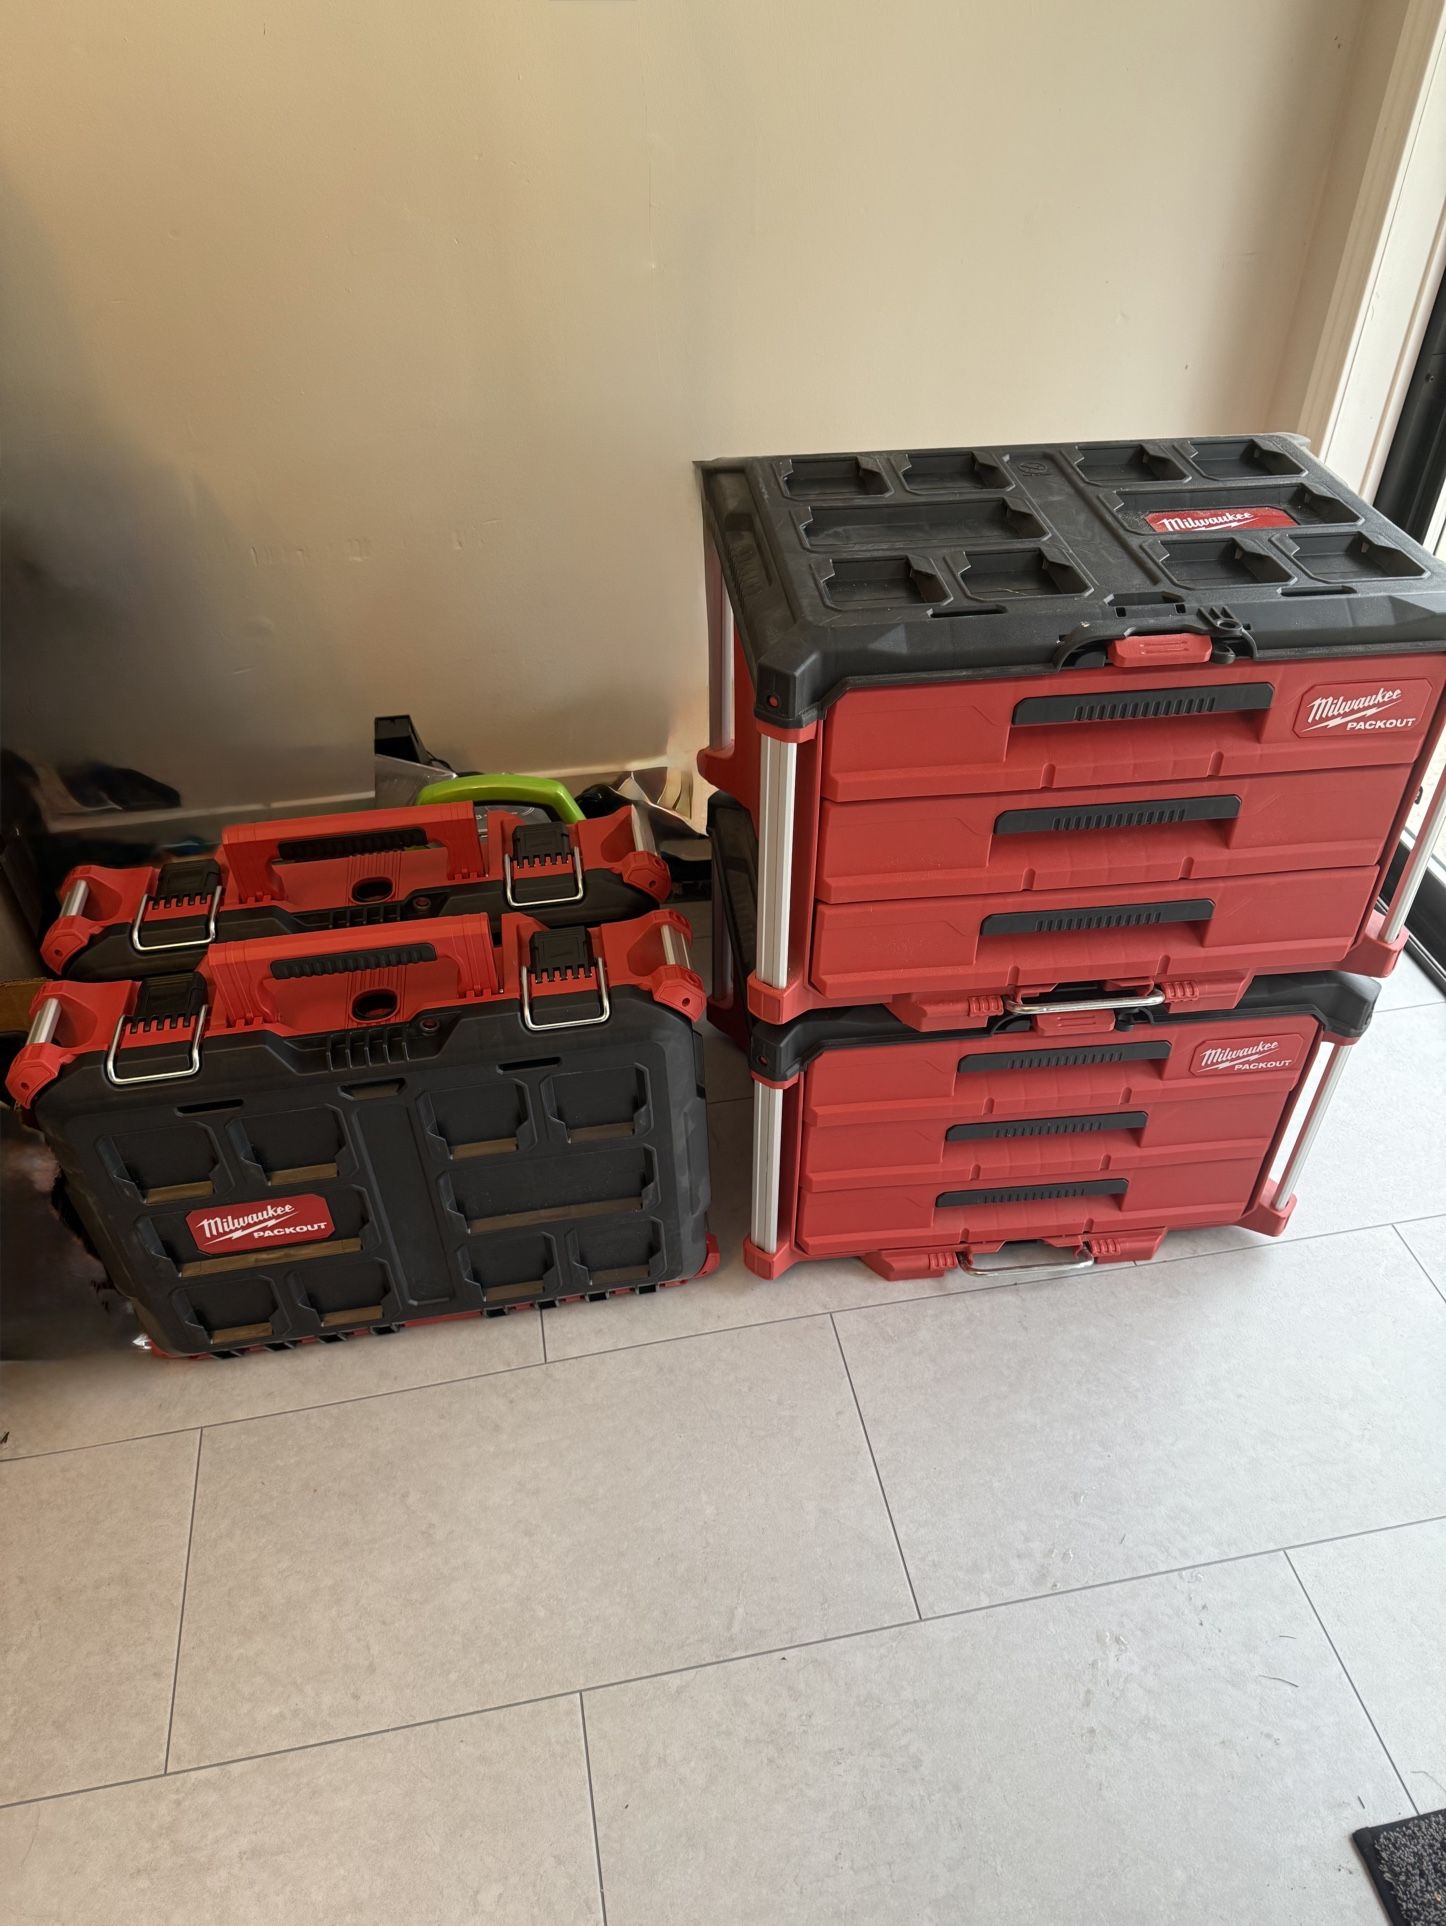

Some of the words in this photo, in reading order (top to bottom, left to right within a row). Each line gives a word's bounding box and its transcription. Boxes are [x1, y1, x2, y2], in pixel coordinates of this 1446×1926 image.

[1157, 512, 1254, 531] Milwaukee
[1307, 688, 1401, 723] Milwaukee
[1346, 718, 1416, 731] PACKOUT
[1200, 1041, 1279, 1066] Milwaukee
[1234, 1060, 1292, 1071] PACKOUT
[195, 1204, 295, 1238] Milwaukee
[253, 1222, 327, 1239] PACKOUT
